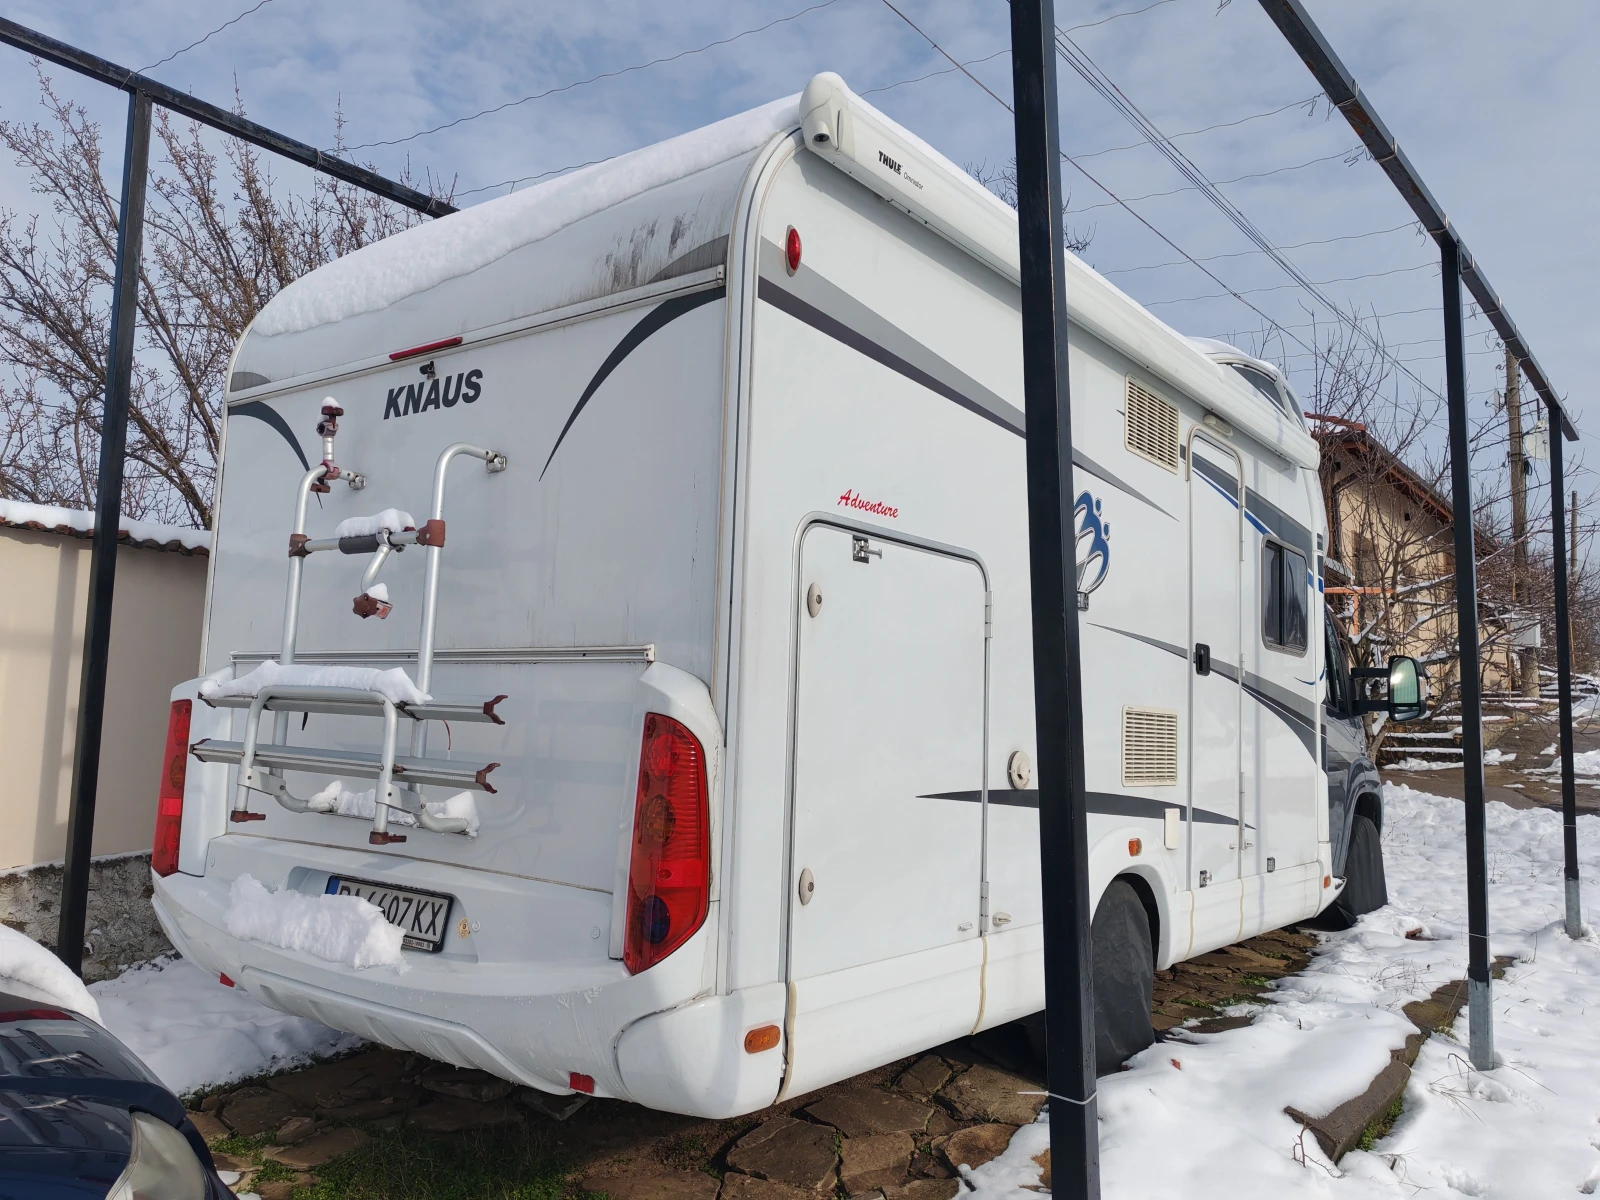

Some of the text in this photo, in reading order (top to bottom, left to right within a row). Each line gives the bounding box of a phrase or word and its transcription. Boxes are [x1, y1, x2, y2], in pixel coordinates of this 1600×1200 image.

[878, 149, 902, 174] THULE
[383, 368, 484, 420] KNAUS
[837, 488, 899, 518] Adventure
